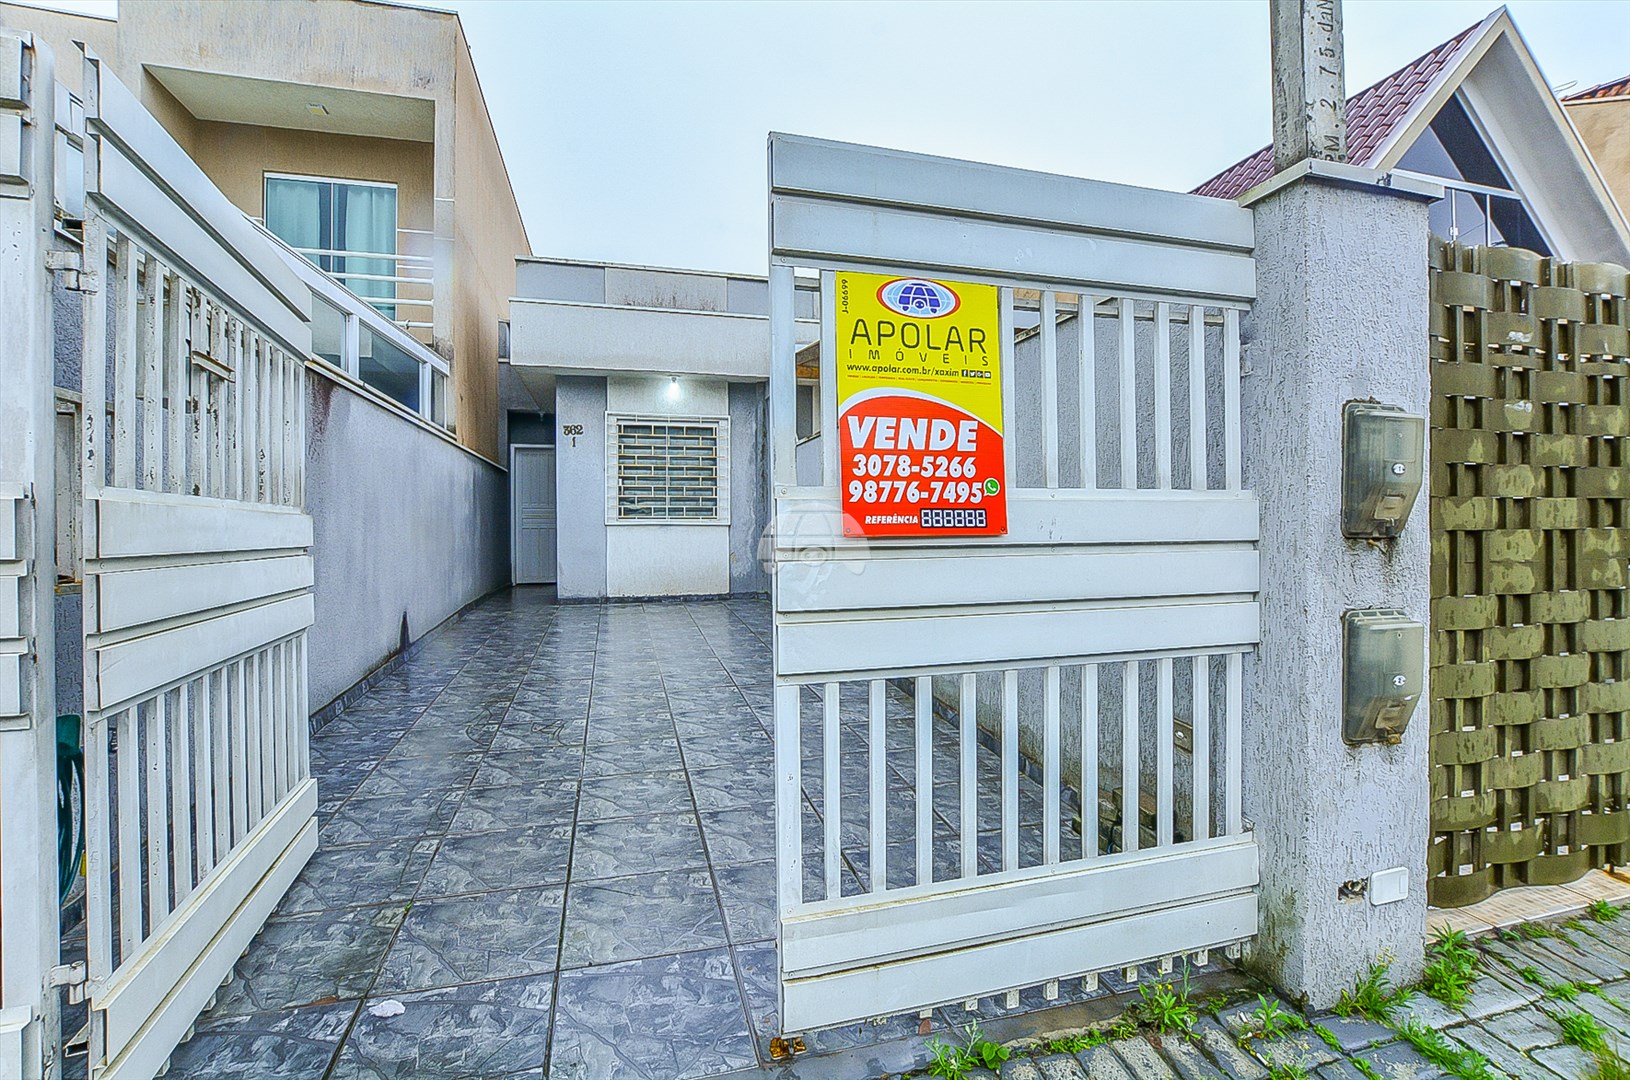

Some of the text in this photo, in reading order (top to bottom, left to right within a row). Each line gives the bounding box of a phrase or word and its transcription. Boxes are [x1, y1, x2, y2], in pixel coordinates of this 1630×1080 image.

[841, 279, 849, 314] J-06699
[850, 318, 987, 354] APOLAR
[848, 348, 989, 367] IMÓVEIS
[847, 364, 960, 377] www.apolar.com.br/xaxim
[563, 424, 584, 436] 362
[847, 415, 979, 452] VENDE
[852, 453, 977, 479] 3078-5266
[848, 479, 983, 504] 98776-7495
[864, 512, 919, 525] REFERÊNCIA
